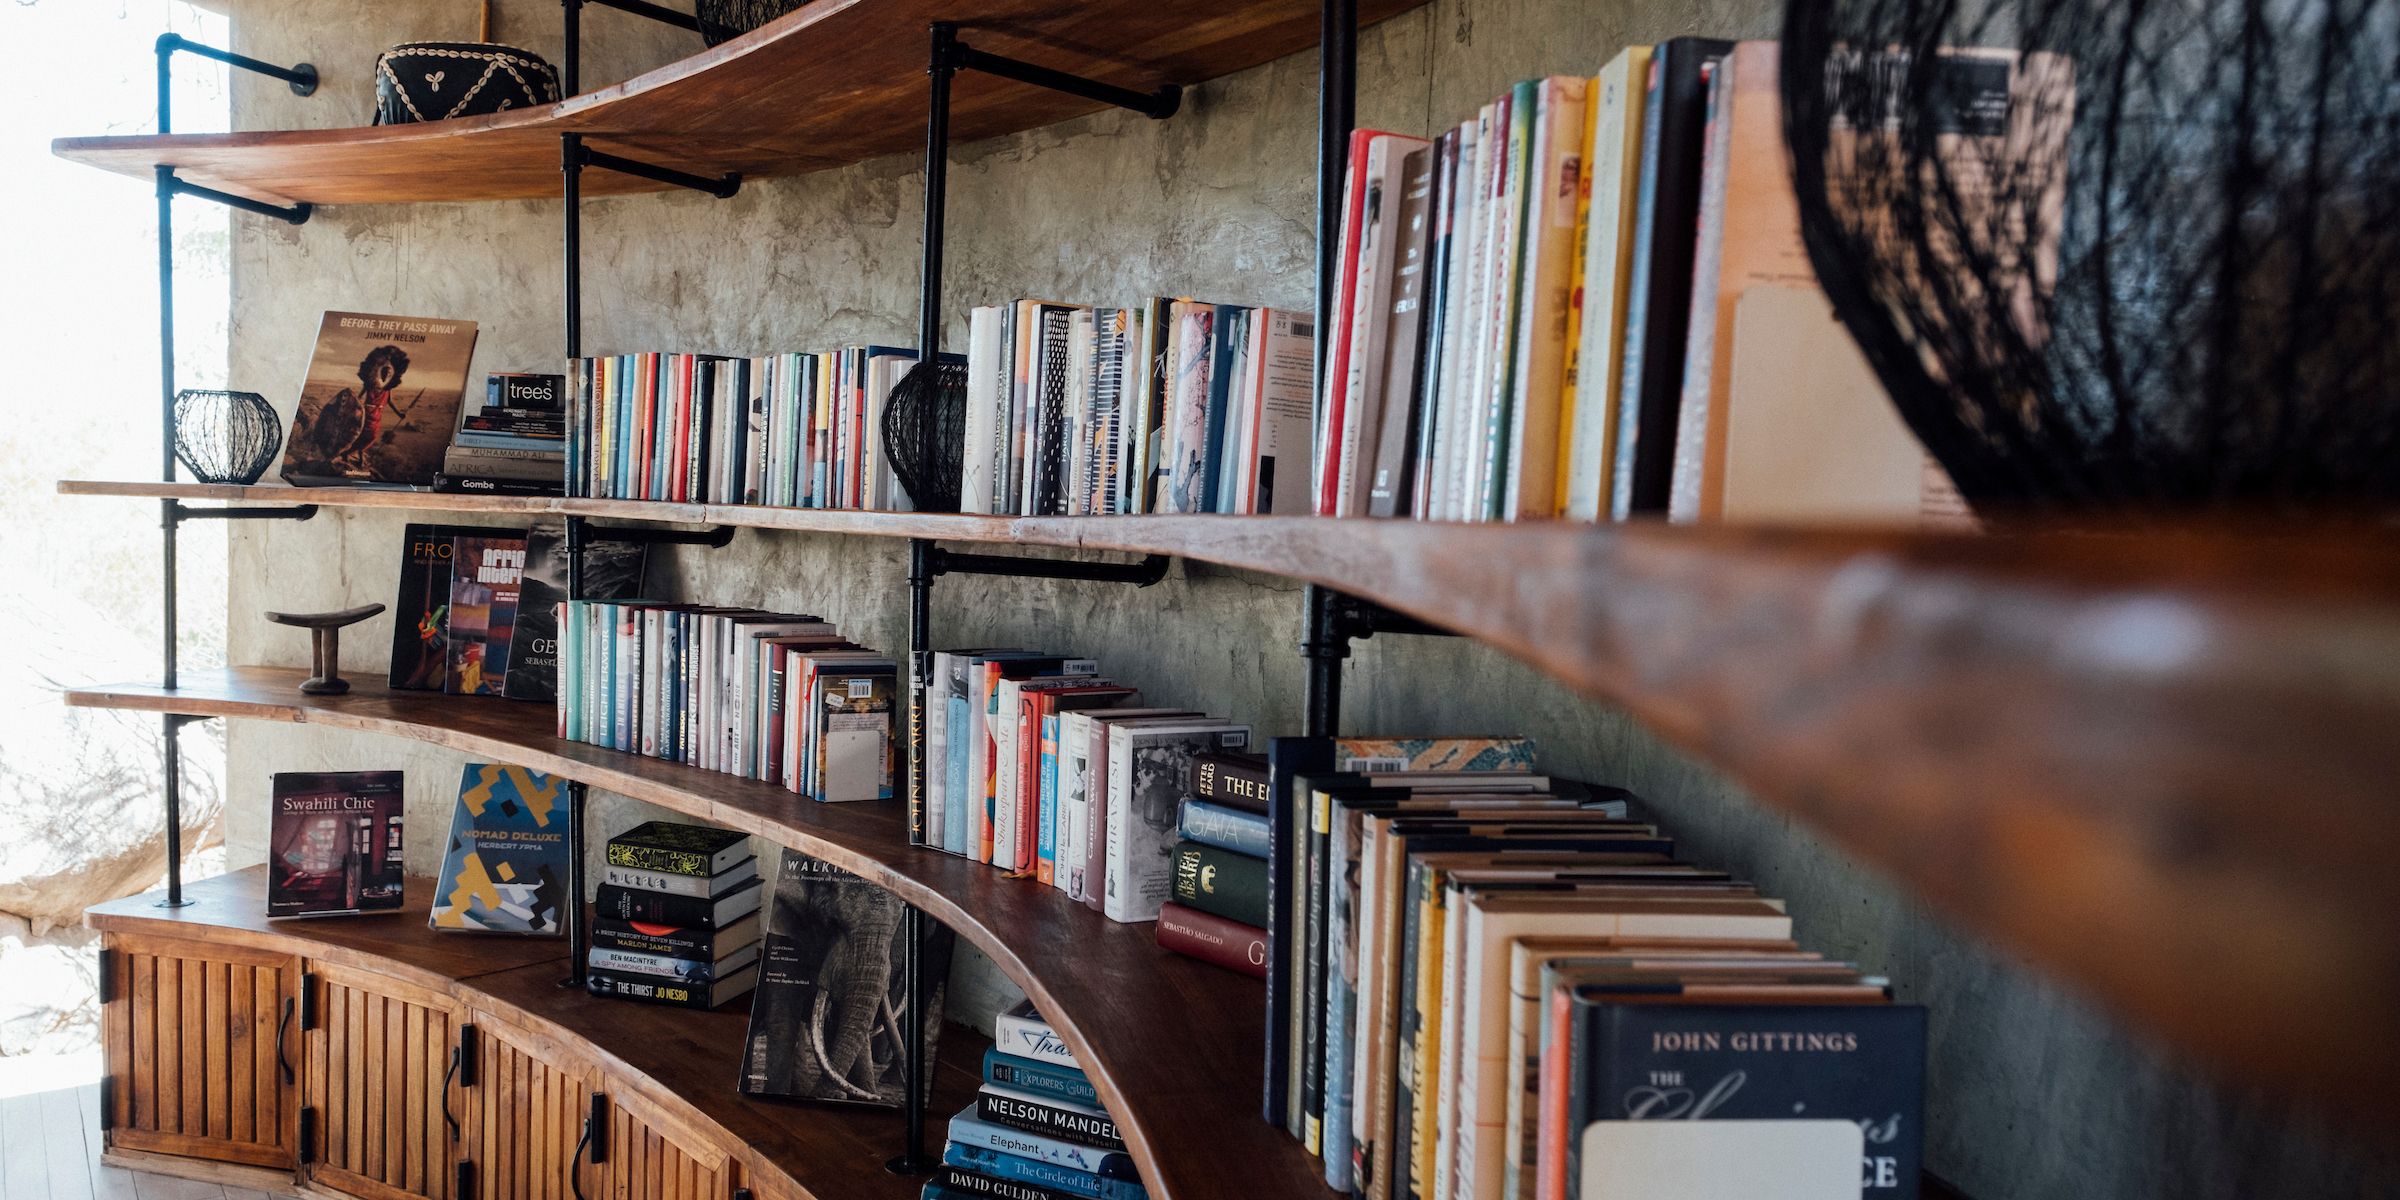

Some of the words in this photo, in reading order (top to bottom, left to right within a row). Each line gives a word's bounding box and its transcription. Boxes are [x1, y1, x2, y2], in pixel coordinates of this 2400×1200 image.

[340, 317, 376, 330] BEFORE
[378, 319, 401, 331] THEY
[402, 321, 427, 333] PASS
[429, 323, 457, 335] AWAY
[365, 331, 391, 342] JIMMY
[394, 333, 426, 344] NELSON
[1087, 331, 1099, 394] FISHERMEN
[510, 382, 552, 400] trees
[1064, 354, 1072, 414] MURAKAMI
[472, 448, 528, 458] MUHAMMAD
[531, 451, 546, 459] ALI
[1061, 422, 1069, 462] HARUKI
[1084, 421, 1094, 463] OBIOMA
[450, 463, 495, 475] AFRICA
[462, 480, 495, 489] Gombe
[1081, 465, 1092, 512] CHIGOZIE
[601, 629, 609, 690] FERMOR
[600, 692, 608, 737] LEIGH
[688, 693, 697, 759] Mankell
[1000, 725, 1009, 749] Me
[1042, 764, 1047, 775] OF
[1200, 763, 1208, 795] PETER
[1207, 763, 1216, 796] BEARD
[1045, 792, 1050, 803] ON
[1088, 767, 1096, 803] Work
[1224, 776, 1254, 797] THE
[283, 797, 337, 811] Swahili
[343, 797, 375, 809] Chic
[911, 785, 922, 835] JOHN
[997, 771, 1009, 848] Shakespeare
[1108, 759, 1119, 858] PIRANESI
[462, 830, 508, 840] NOMAD
[512, 831, 562, 843] DELUXE
[1087, 806, 1096, 860] Camera
[1187, 808, 1239, 844] GAIA
[478, 841, 517, 850] HERBERT
[519, 843, 543, 851] YPMA
[610, 871, 666, 889] MULTIPLES
[1178, 850, 1192, 897] PETER
[1187, 850, 1201, 900] BEARD
[1310, 853, 1322, 948] Olympus
[617, 931, 641, 940] HISTORY
[650, 935, 668, 943] SEVEN
[668, 937, 694, 948] KILLINGS
[617, 939, 647, 949] MARLON
[648, 942, 672, 952] JAMES
[1163, 921, 1194, 937] SEBASTIÃO
[1194, 930, 1223, 945] SALGADO
[601, 960, 616, 968] SPY
[617, 962, 643, 972] AMONG
[644, 965, 674, 976] FRIENDS
[610, 953, 623, 962] BEN
[624, 954, 657, 966] MACINTYRE
[1309, 957, 1319, 978] of
[617, 981, 630, 994] THE
[631, 983, 653, 997] THIRST
[655, 986, 665, 998] JO
[1307, 987, 1317, 1044] Gods
[1652, 1032, 1720, 1052] JOHN
[1730, 1032, 1858, 1052] GITTINGS
[1021, 1069, 1064, 1091] EXPLORERS
[1066, 1081, 1095, 1097] GUILD
[1306, 1054, 1314, 1090] The
[1650, 1071, 1685, 1087] THE
[988, 1098, 1049, 1124] NELSON
[1054, 1112, 1123, 1140] MANDEL
[1000, 1116, 1063, 1137] Conversations
[1065, 1132, 1084, 1142] with
[1087, 1135, 1117, 1148] Myself
[990, 1134, 1039, 1154] Elephant
[950, 1172, 990, 1192] DAVID
[1015, 1162, 1036, 1176] The
[1035, 1167, 1067, 1184] Circle
[1068, 1174, 1079, 1185] of
[1080, 1175, 1101, 1191] Life
